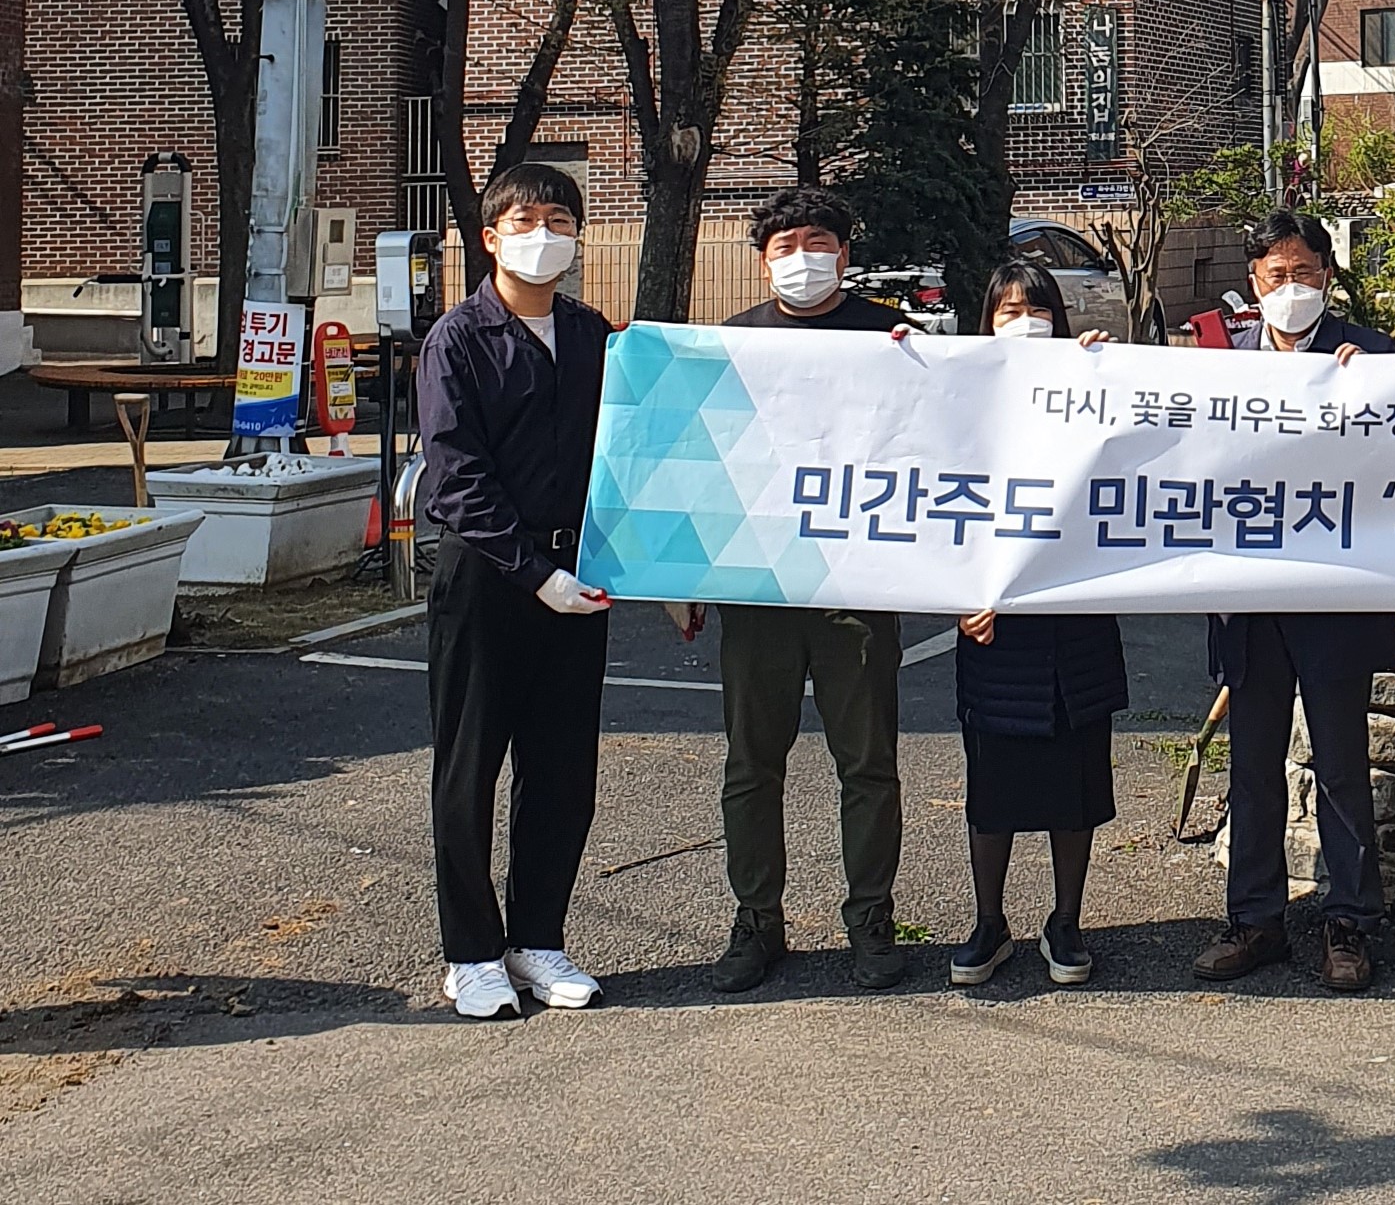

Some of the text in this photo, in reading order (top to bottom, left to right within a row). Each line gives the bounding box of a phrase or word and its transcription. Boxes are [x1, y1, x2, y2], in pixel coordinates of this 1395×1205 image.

[242, 339, 296, 365] 경고문
[1131, 391, 1197, 429] 꽃을
[1207, 395, 1307, 435] 피우는
[792, 464, 1062, 546] 민간주도
[1088, 475, 1355, 550] 민관협치
